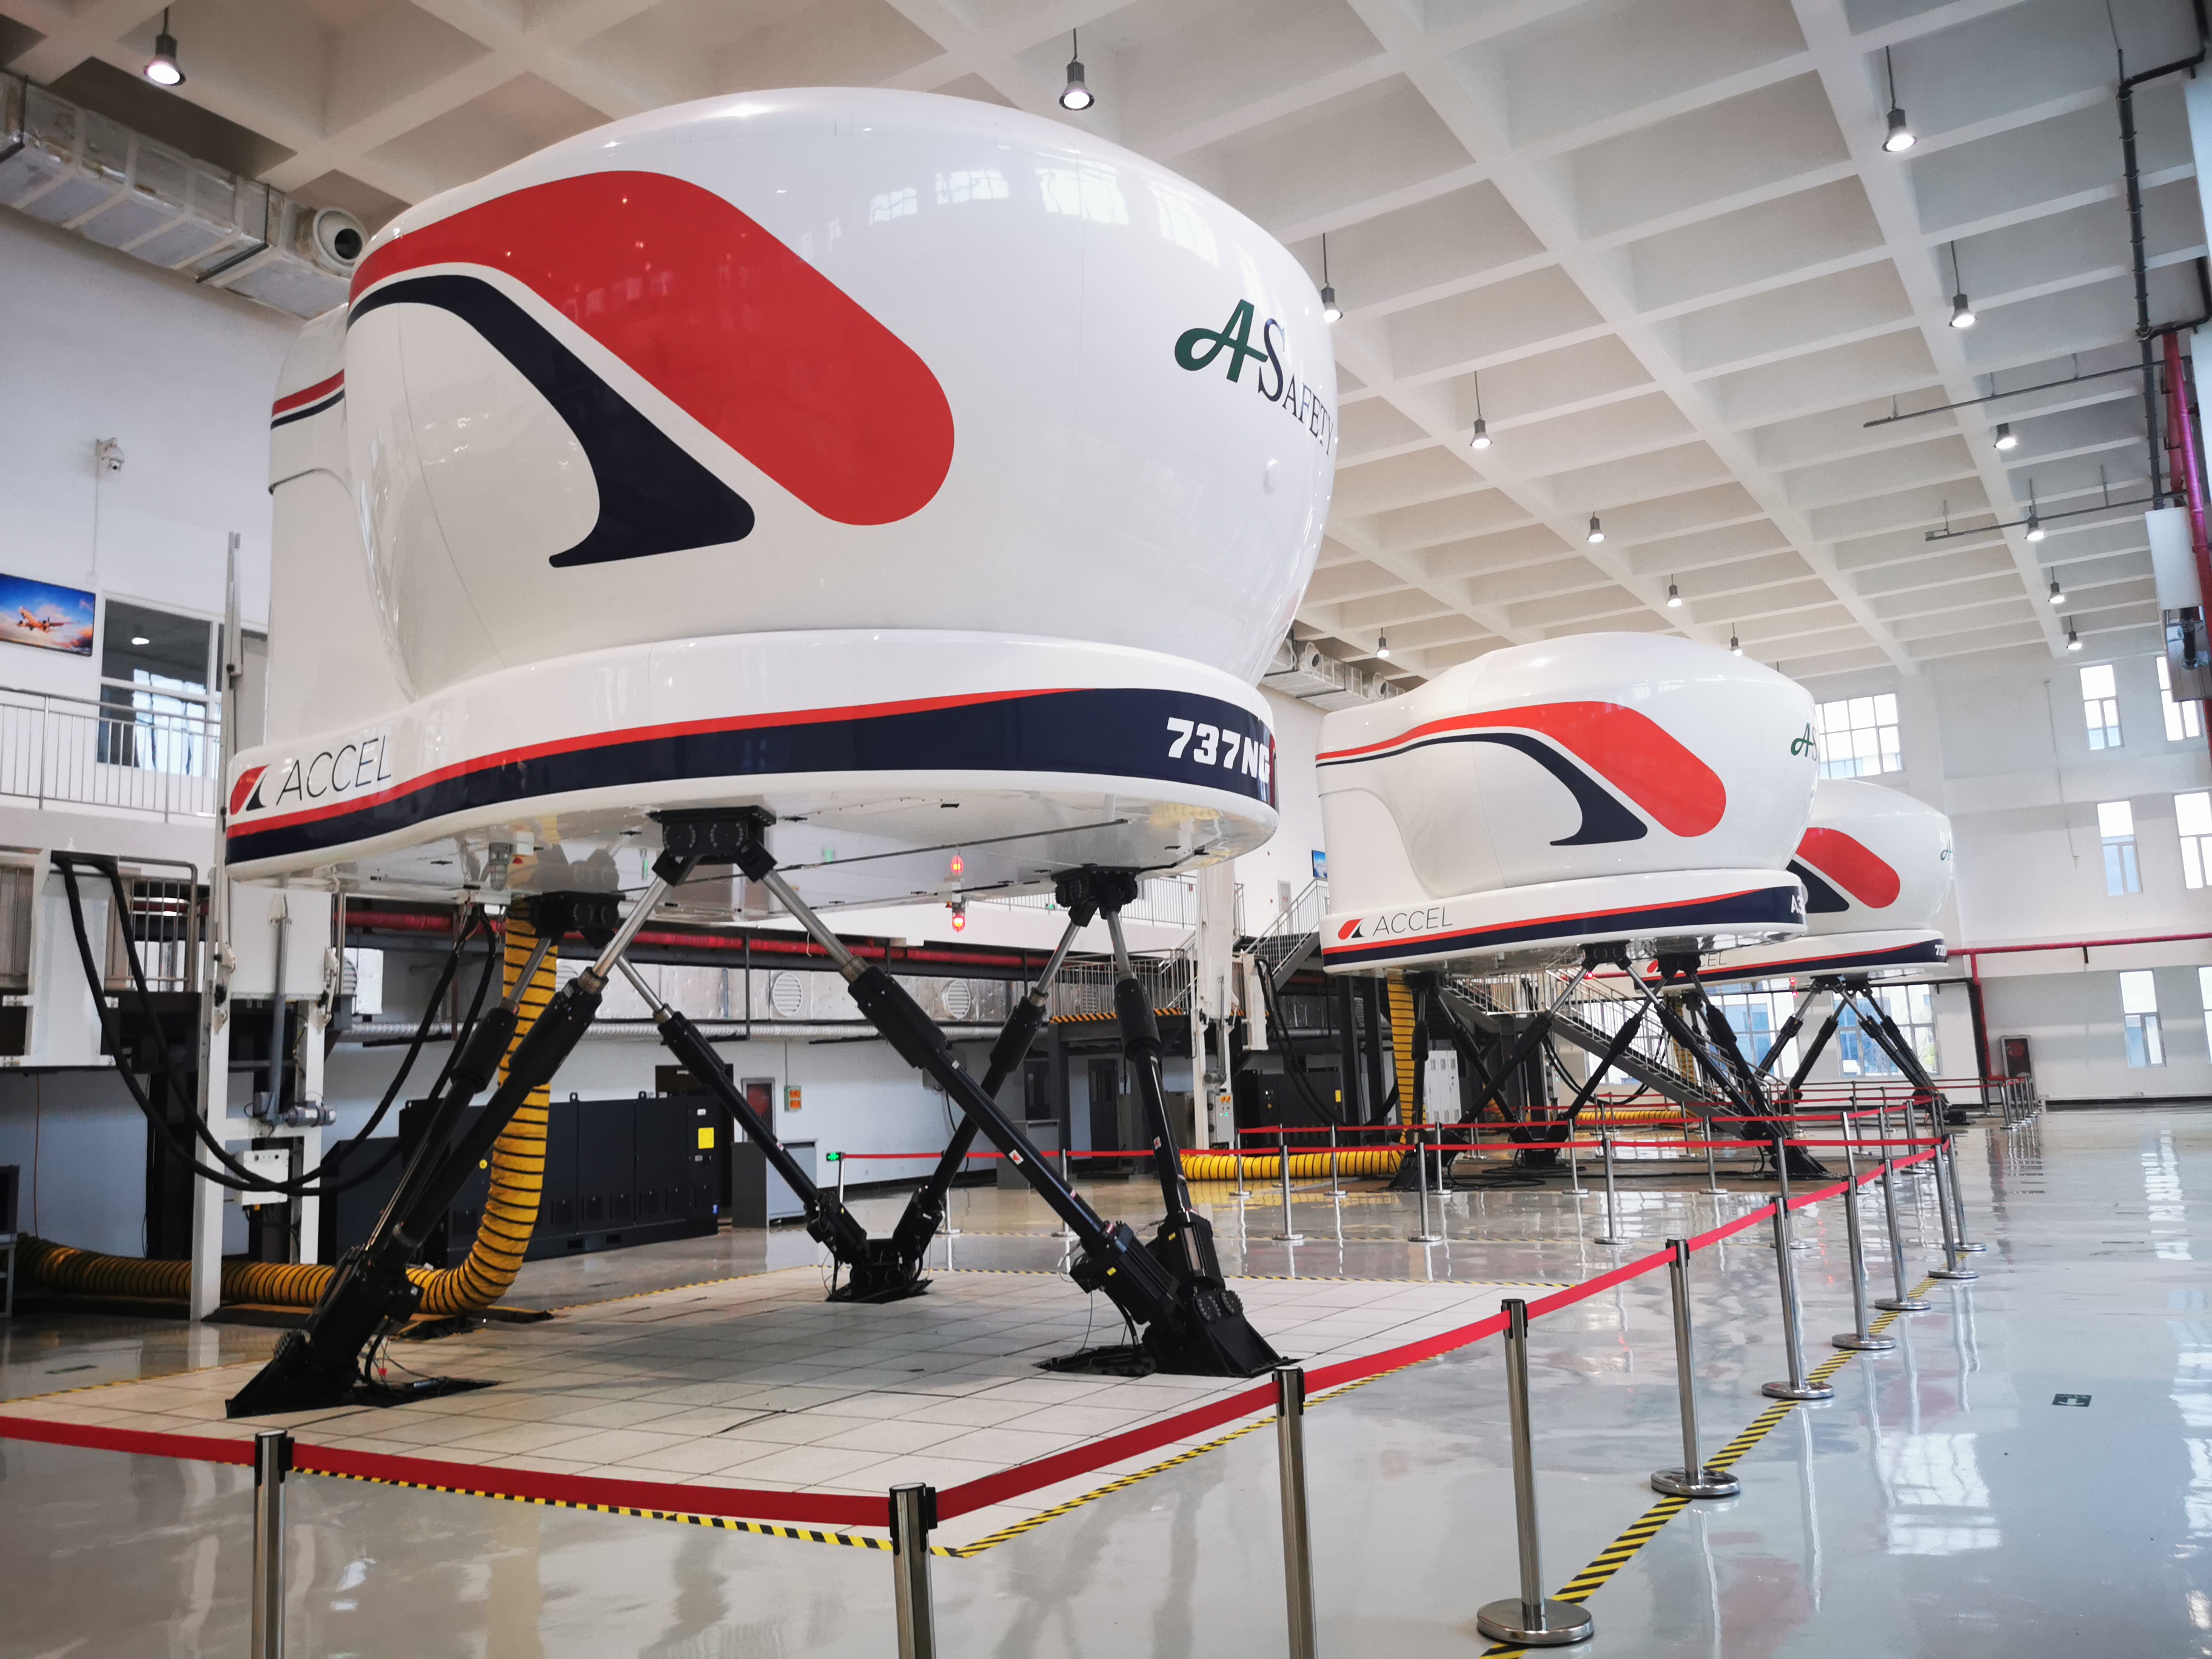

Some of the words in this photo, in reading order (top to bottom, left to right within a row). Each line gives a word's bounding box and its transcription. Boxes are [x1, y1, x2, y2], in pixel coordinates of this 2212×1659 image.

[276, 734, 392, 806] ACCEL
[1166, 717, 1270, 783] 737NG
[1372, 906, 1453, 937] ACCEL
